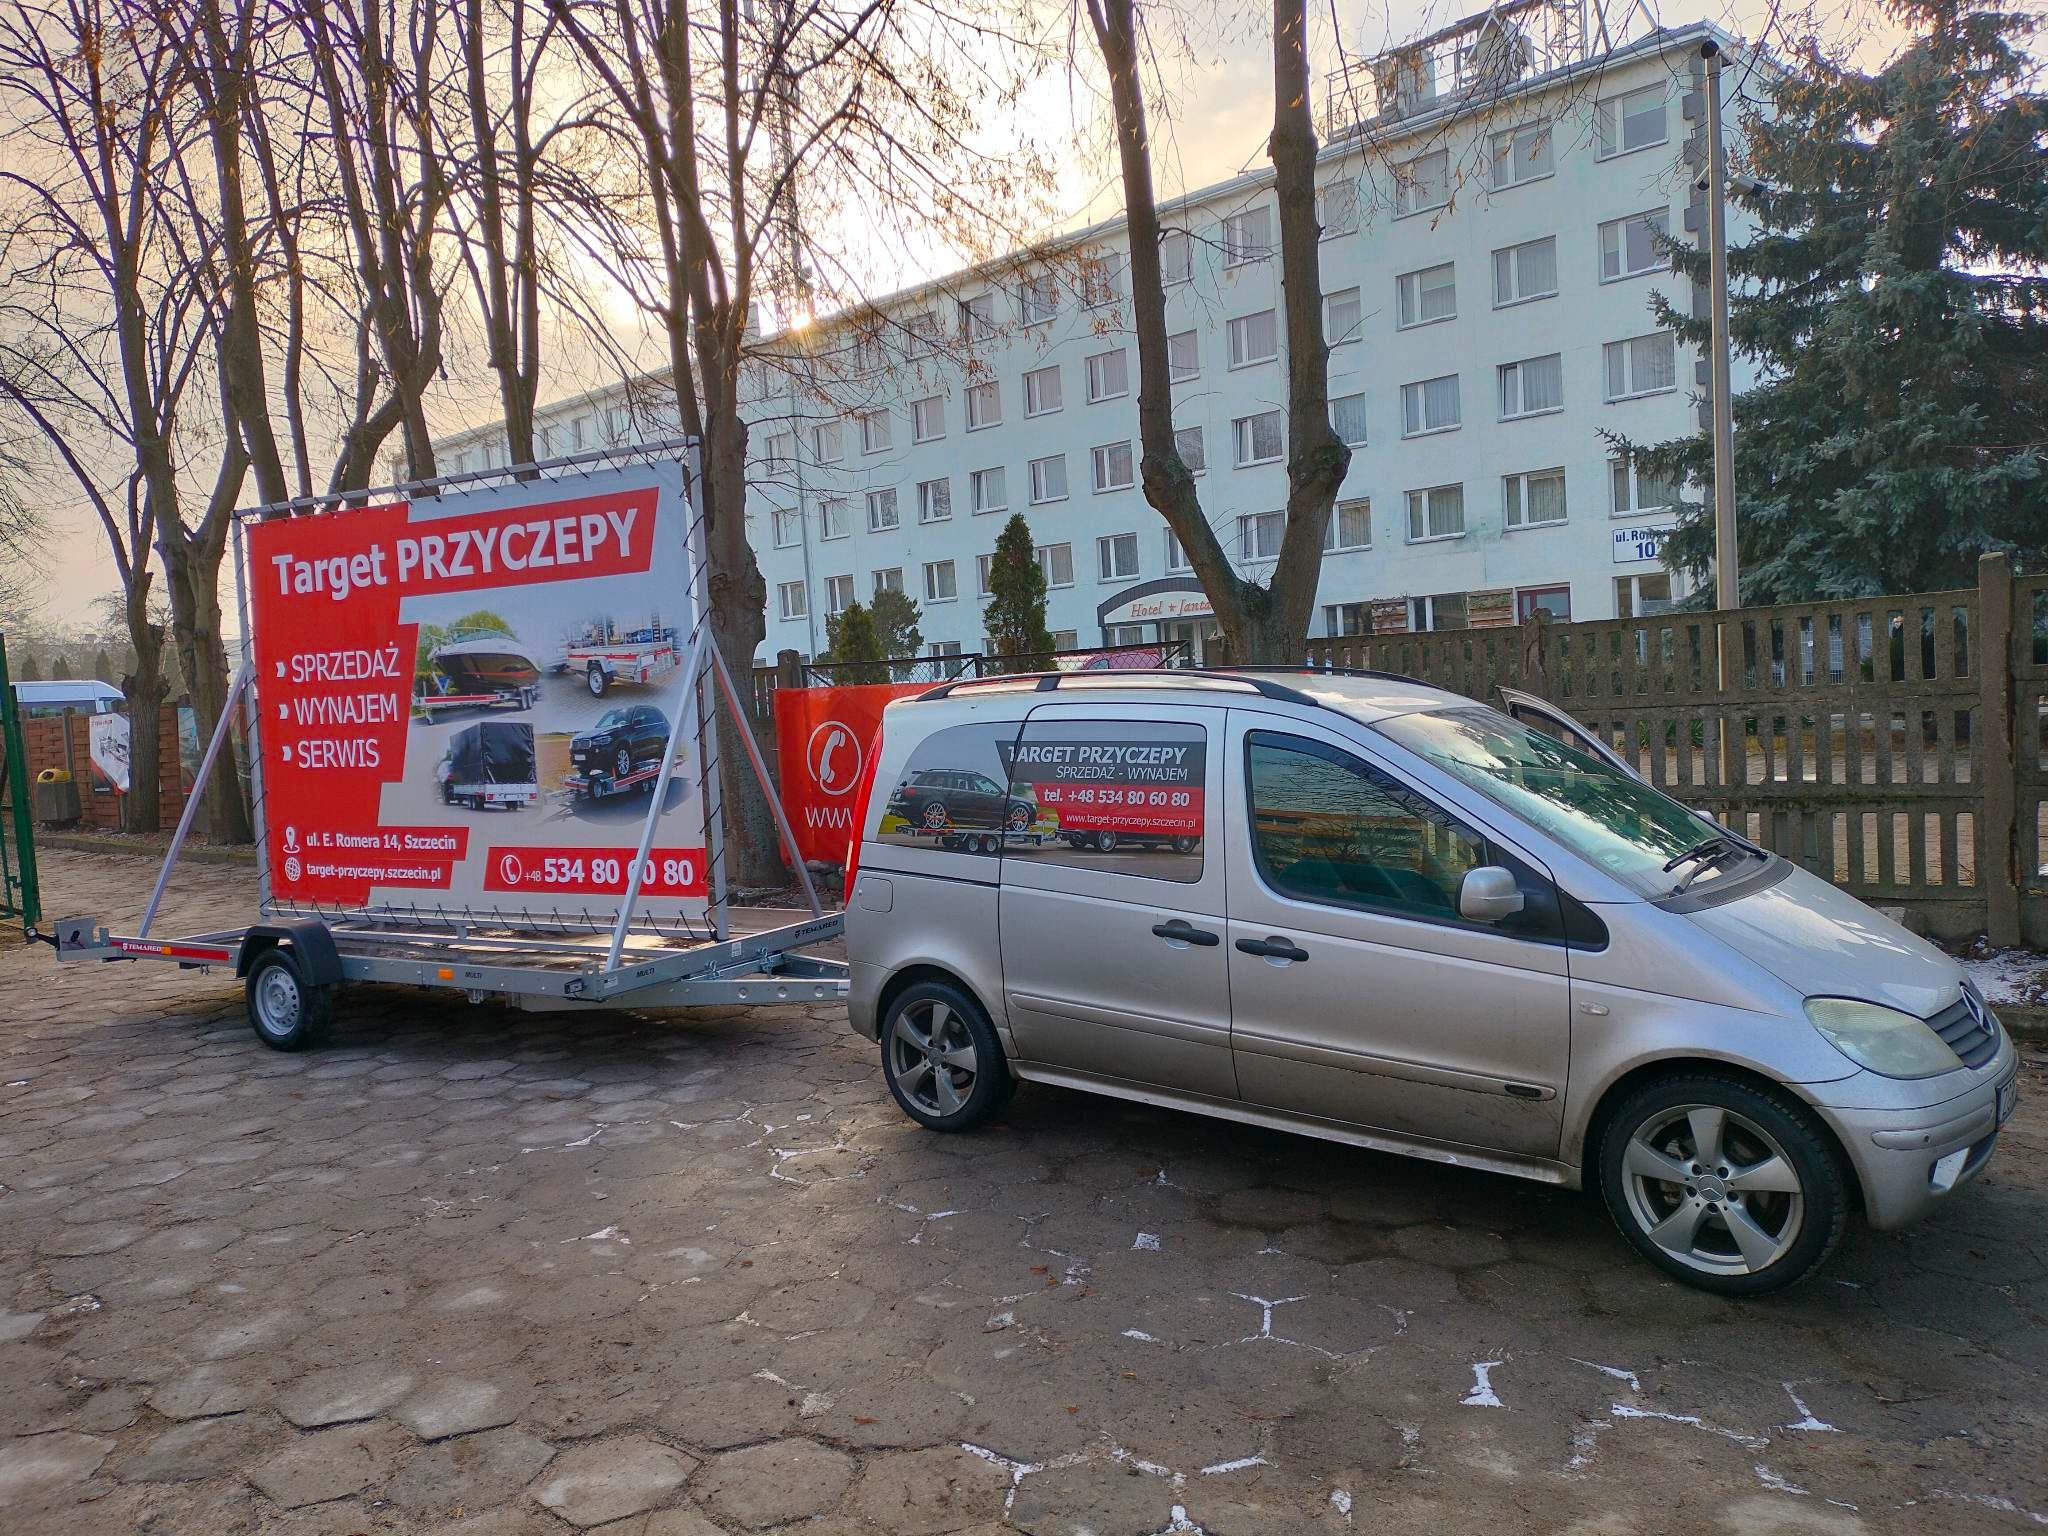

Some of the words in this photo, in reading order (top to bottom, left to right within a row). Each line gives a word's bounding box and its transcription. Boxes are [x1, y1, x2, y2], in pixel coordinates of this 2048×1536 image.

[1615, 531, 1630, 543] ul.
[272, 544, 387, 600] Target
[396, 508, 639, 583] PRZYCZEPY
[1635, 541, 1656, 558] 10
[1131, 600, 1163, 617] Hotel
[291, 641, 400, 683] SPRZEDAŻ
[294, 693, 398, 725] WYNAJEM
[297, 738, 379, 769] SERWIS
[1008, 746, 1076, 764] TARGET
[1078, 746, 1188, 765] PRZYCZEPY
[1056, 764, 1116, 780] SPRZEDAŻ
[1128, 767, 1188, 781] WYNAJEM
[1044, 788, 1063, 802] tel.
[1068, 790, 1094, 804] +48
[1098, 790, 1124, 804] 534
[1128, 791, 1146, 805] 80
[1149, 791, 1168, 806] 60
[1171, 792, 1190, 807] 80
[1066, 813, 1196, 829] www.target-przyczepy.szczecin.pl
[306, 832, 320, 847] ul.
[323, 833, 333, 847] E.
[336, 833, 380, 849] Romera
[383, 834, 401, 852] 14,
[404, 834, 457, 850] Szczecin
[306, 863, 441, 882] target-przyczepy.szczecin.pl
[524, 870, 542, 882] +48
[544, 857, 585, 883] 534
[591, 858, 620, 885] 80
[663, 859, 694, 886] 80
